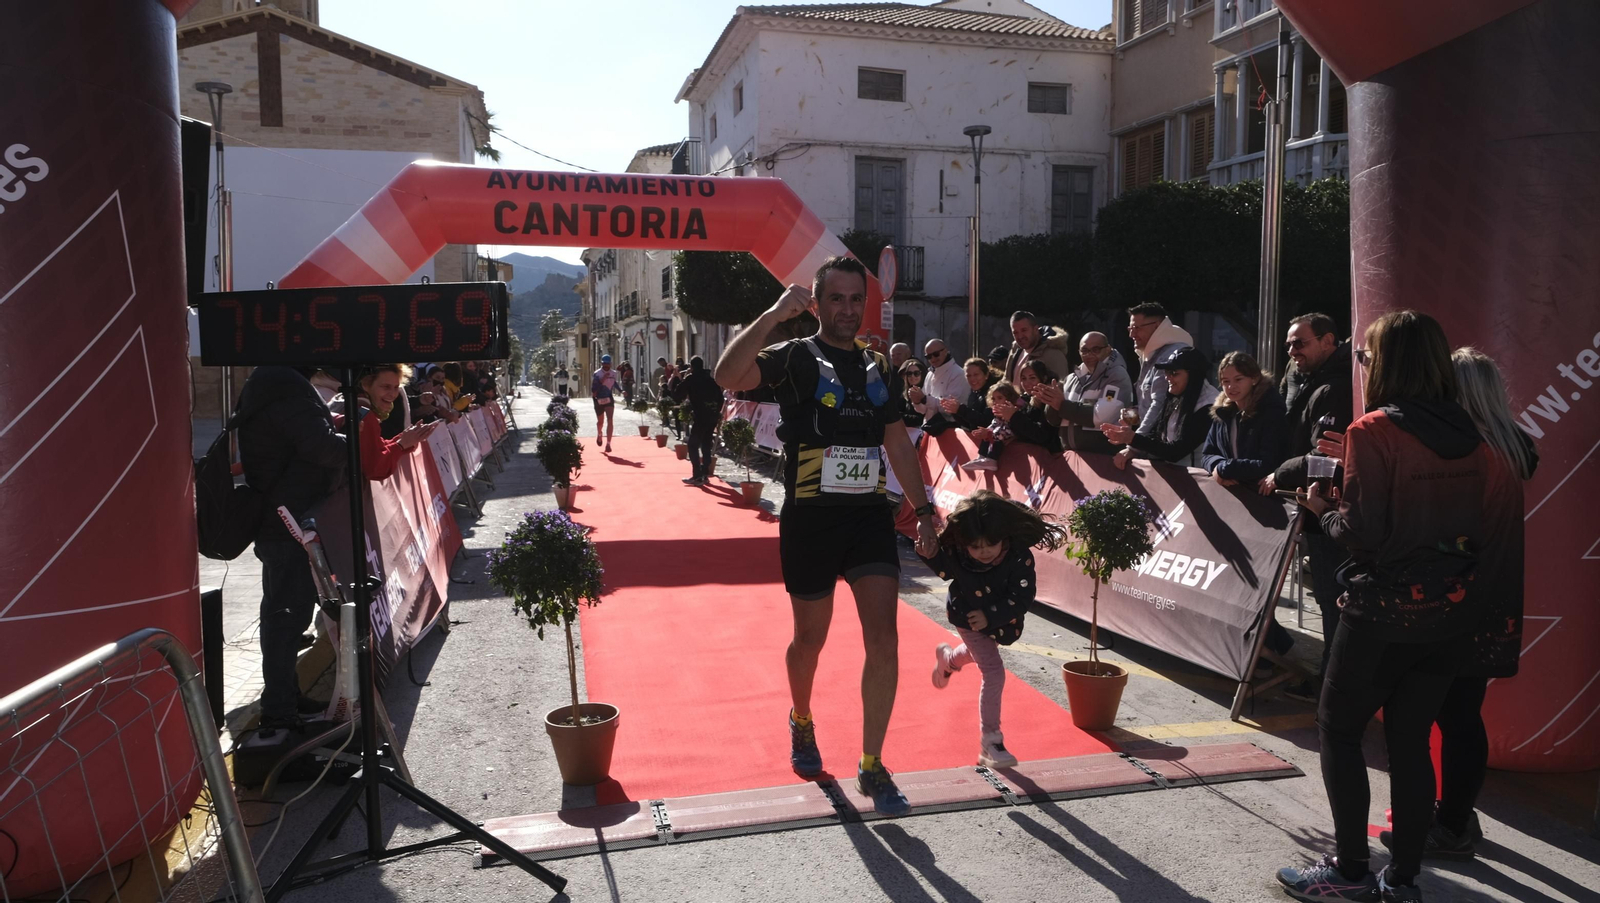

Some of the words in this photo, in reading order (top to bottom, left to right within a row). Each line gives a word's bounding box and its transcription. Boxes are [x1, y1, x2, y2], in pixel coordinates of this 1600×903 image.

[486, 171, 716, 197] AYUNTAMIENTO
[493, 200, 708, 240] CANTORIA
[216, 290, 491, 354] 74:57.69
[835, 462, 870, 481] 344
[1111, 581, 1176, 611] www.teamergy.es
[1398, 601, 1440, 610] COSENTINO
